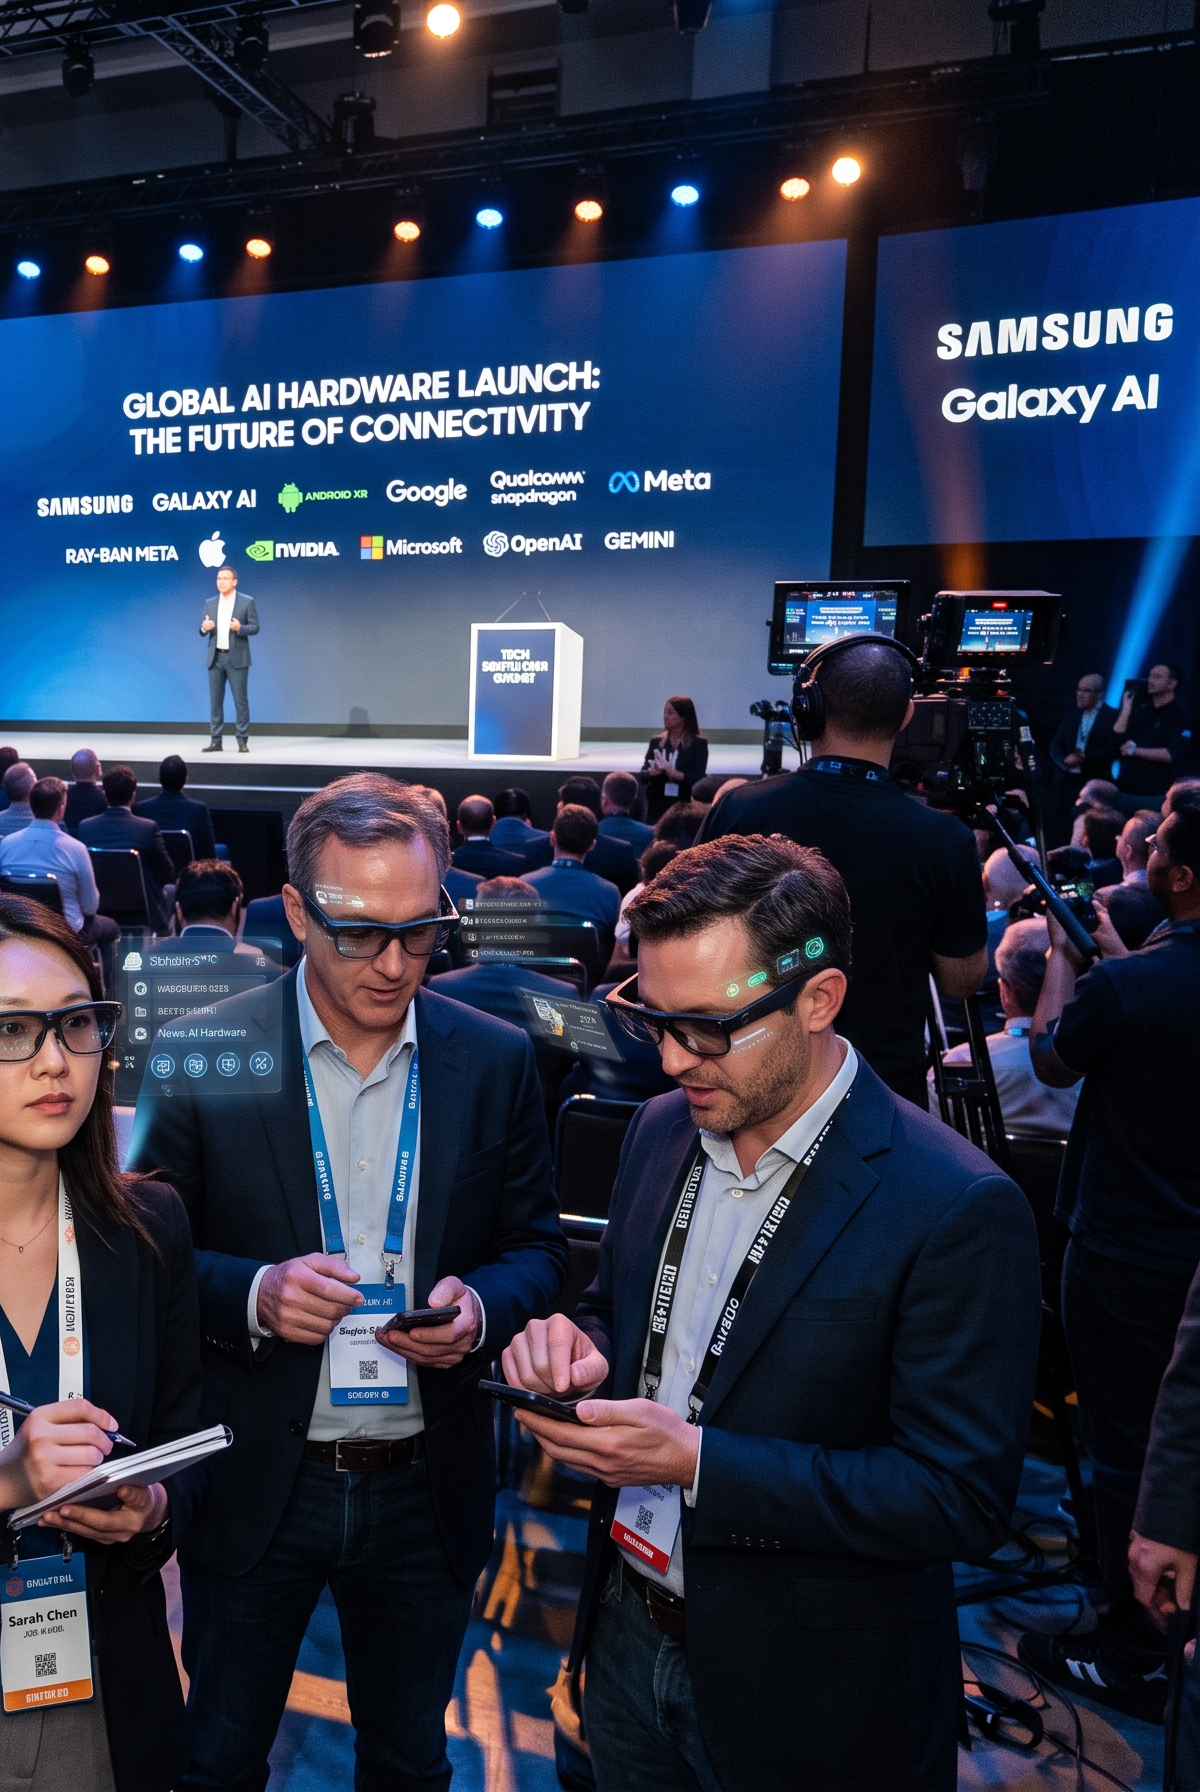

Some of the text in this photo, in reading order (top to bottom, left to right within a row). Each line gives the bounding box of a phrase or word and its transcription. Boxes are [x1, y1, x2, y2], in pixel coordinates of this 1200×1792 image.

[937, 303, 1174, 360] SAMSUNG
[123, 361, 600, 419] GLOBAL AI HARDWARE LAUNCH:
[941, 374, 1160, 423] Galaxy AI
[129, 401, 592, 455] THE FUTURE OF CONNECTIVITY
[490, 469, 586, 489] Qualcomm
[644, 469, 712, 493] Meta
[152, 489, 257, 512] GALAXY AI
[304, 489, 368, 501] ANDROID XR
[386, 478, 468, 507] Google
[490, 487, 577, 506] snapdragon
[37, 494, 134, 517] SAMSUNG
[386, 537, 463, 556] Microsoft
[511, 533, 583, 556] OpenAI
[604, 530, 675, 550] GEMINI
[65, 545, 179, 564] RAY-BAN META
[188, 1028, 198, 1038] AI
[200, 1028, 247, 1038] Hardware
[8, 1609, 78, 1628] Sarah Chen
